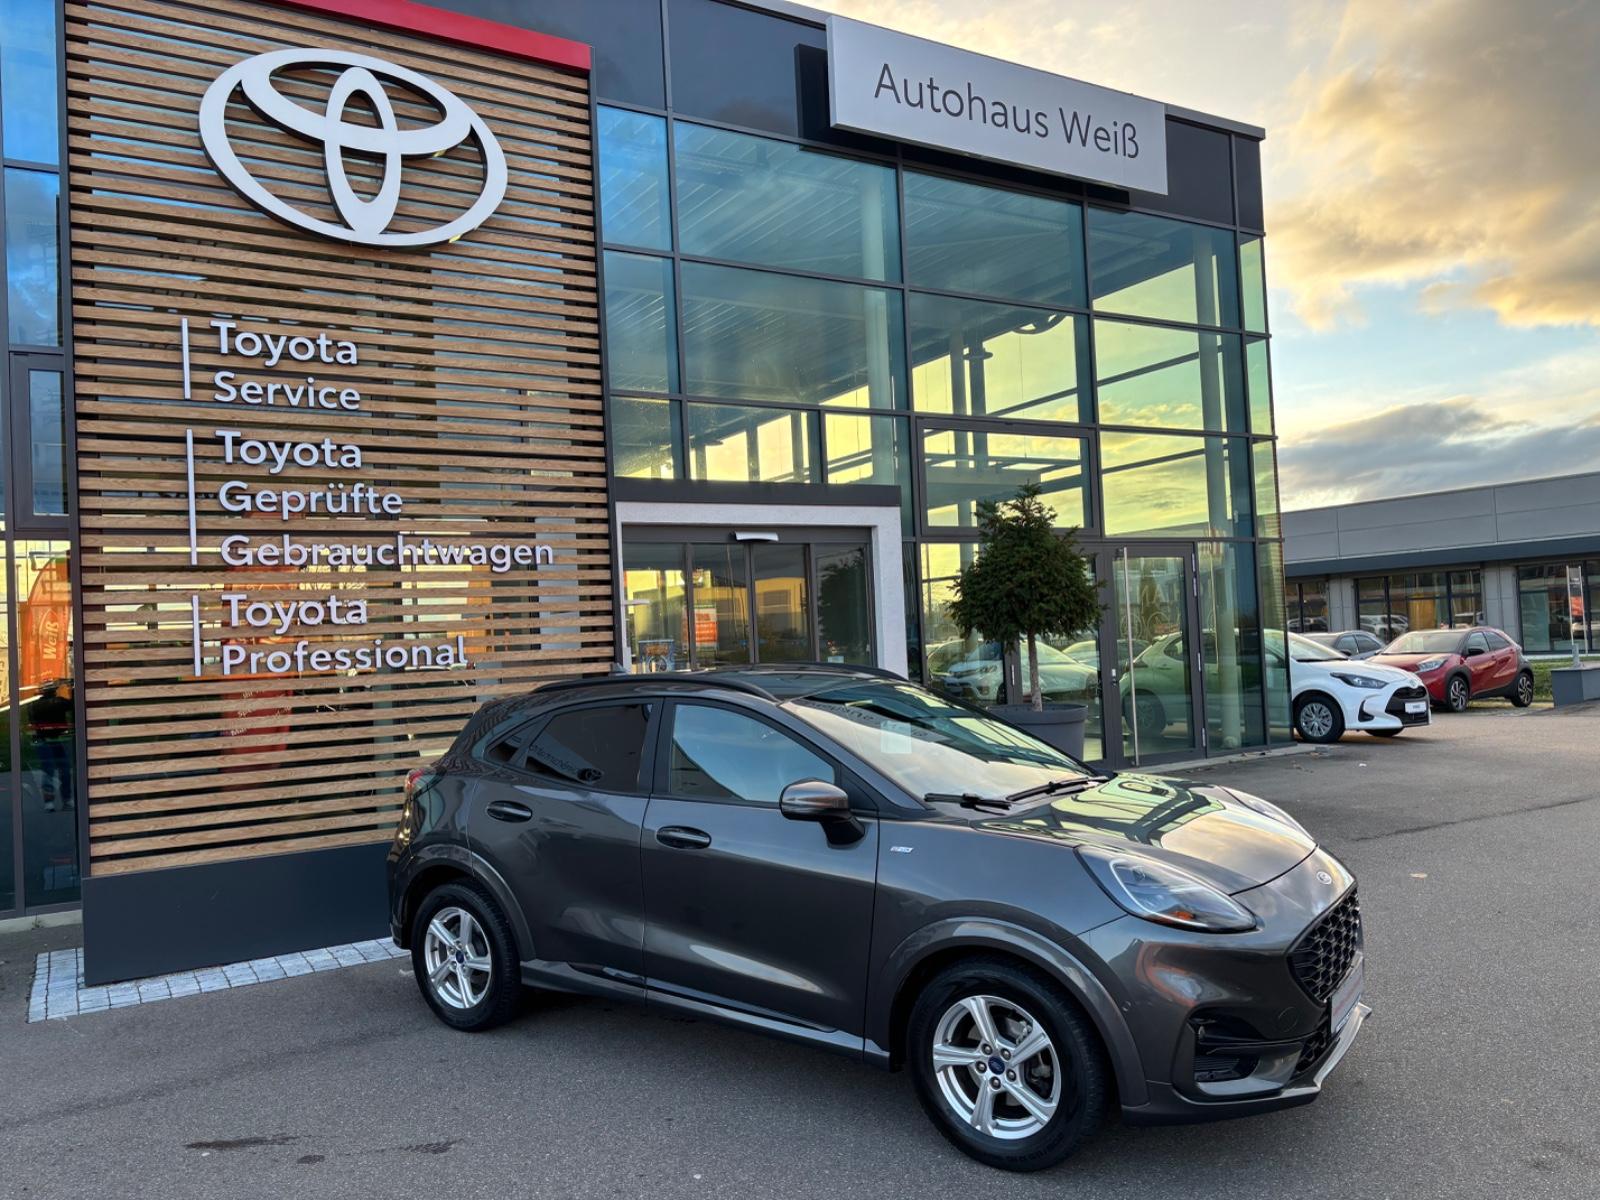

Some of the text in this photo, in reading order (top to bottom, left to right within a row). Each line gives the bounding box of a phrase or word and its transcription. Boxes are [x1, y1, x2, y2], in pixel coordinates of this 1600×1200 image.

[874, 64, 1139, 159] Autohaus Weiß
[211, 320, 358, 366] Toyota
[214, 371, 361, 410] Service
[216, 430, 363, 473] Toyota
[219, 481, 403, 520] Geprüfte
[221, 534, 554, 572] Gebrauchtwagen
[222, 594, 368, 635] Toyota
[223, 636, 468, 675] Professional
